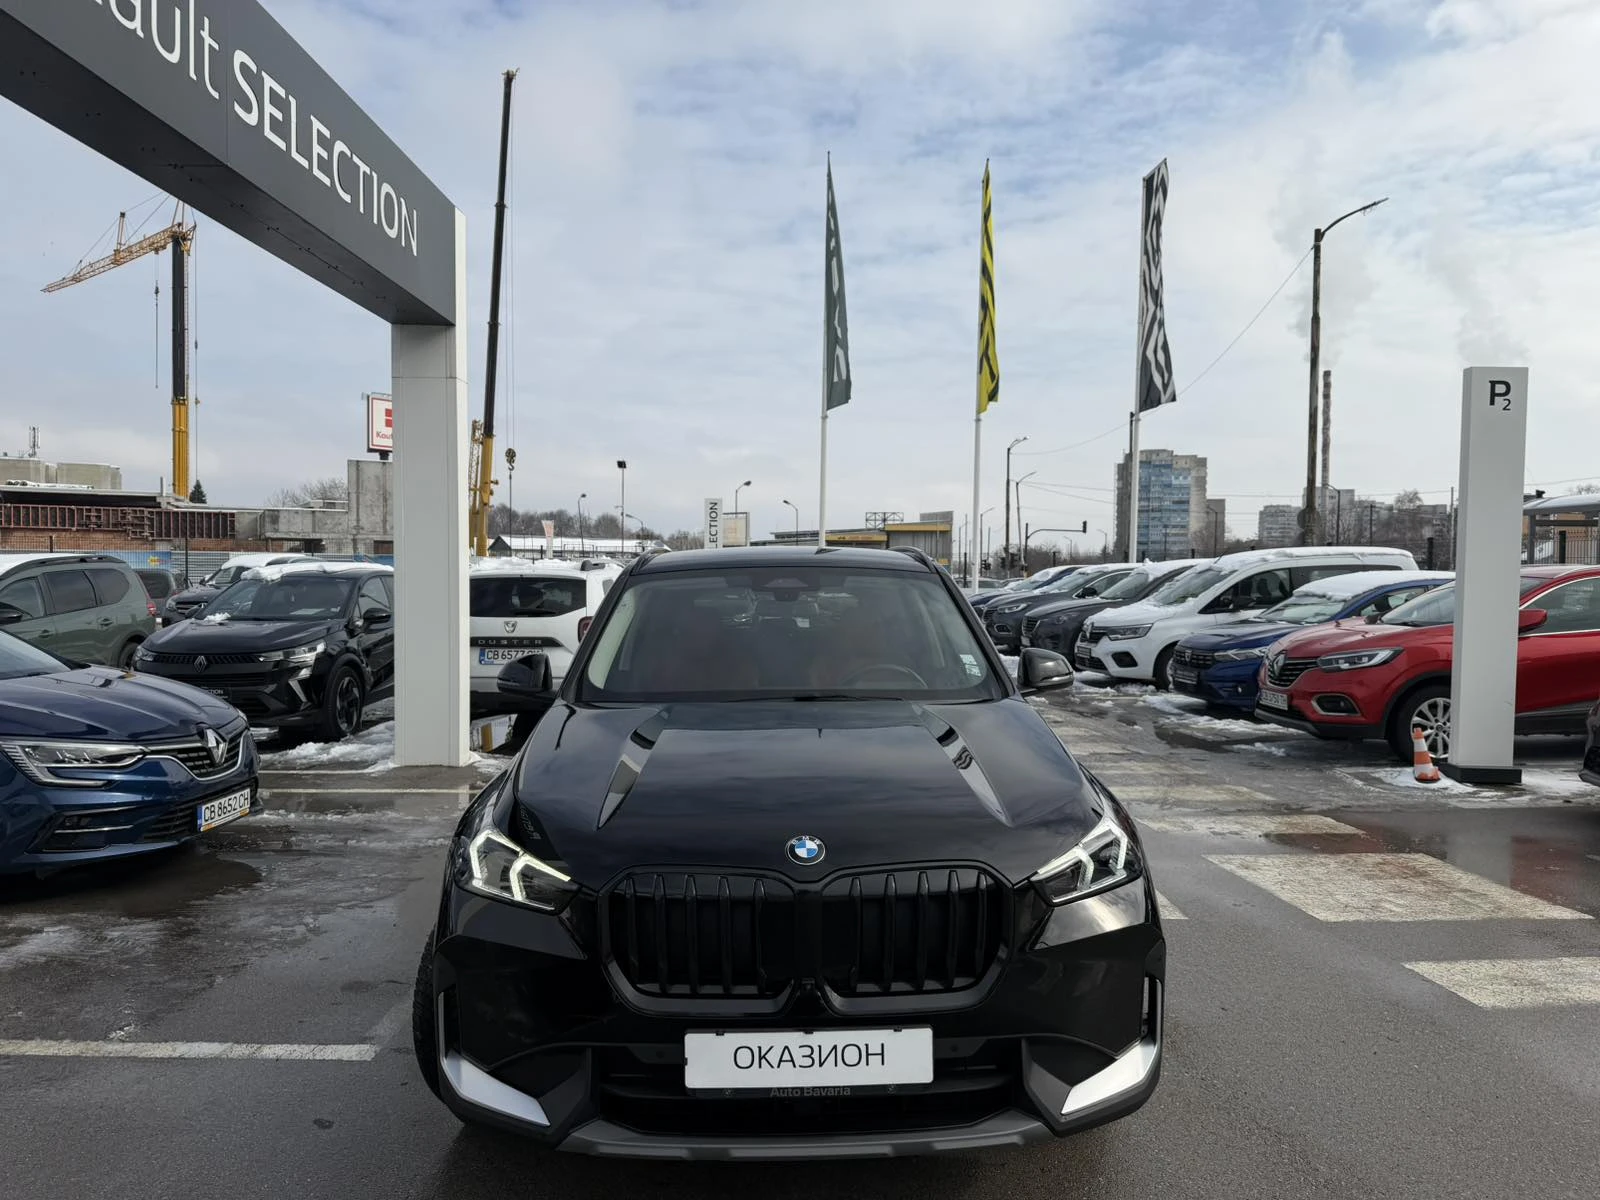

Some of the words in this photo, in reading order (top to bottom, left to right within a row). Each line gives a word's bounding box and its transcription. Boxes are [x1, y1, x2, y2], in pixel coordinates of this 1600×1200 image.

[95, 0, 219, 100] ault
[233, 49, 417, 257] SELECTION
[217, 796, 238, 817] 8652
[791, 835, 821, 844] BMW
[733, 1042, 885, 1070] ОКАЗИОН
[769, 1087, 802, 1098] Auto
[803, 1085, 851, 1098] Bavaria
